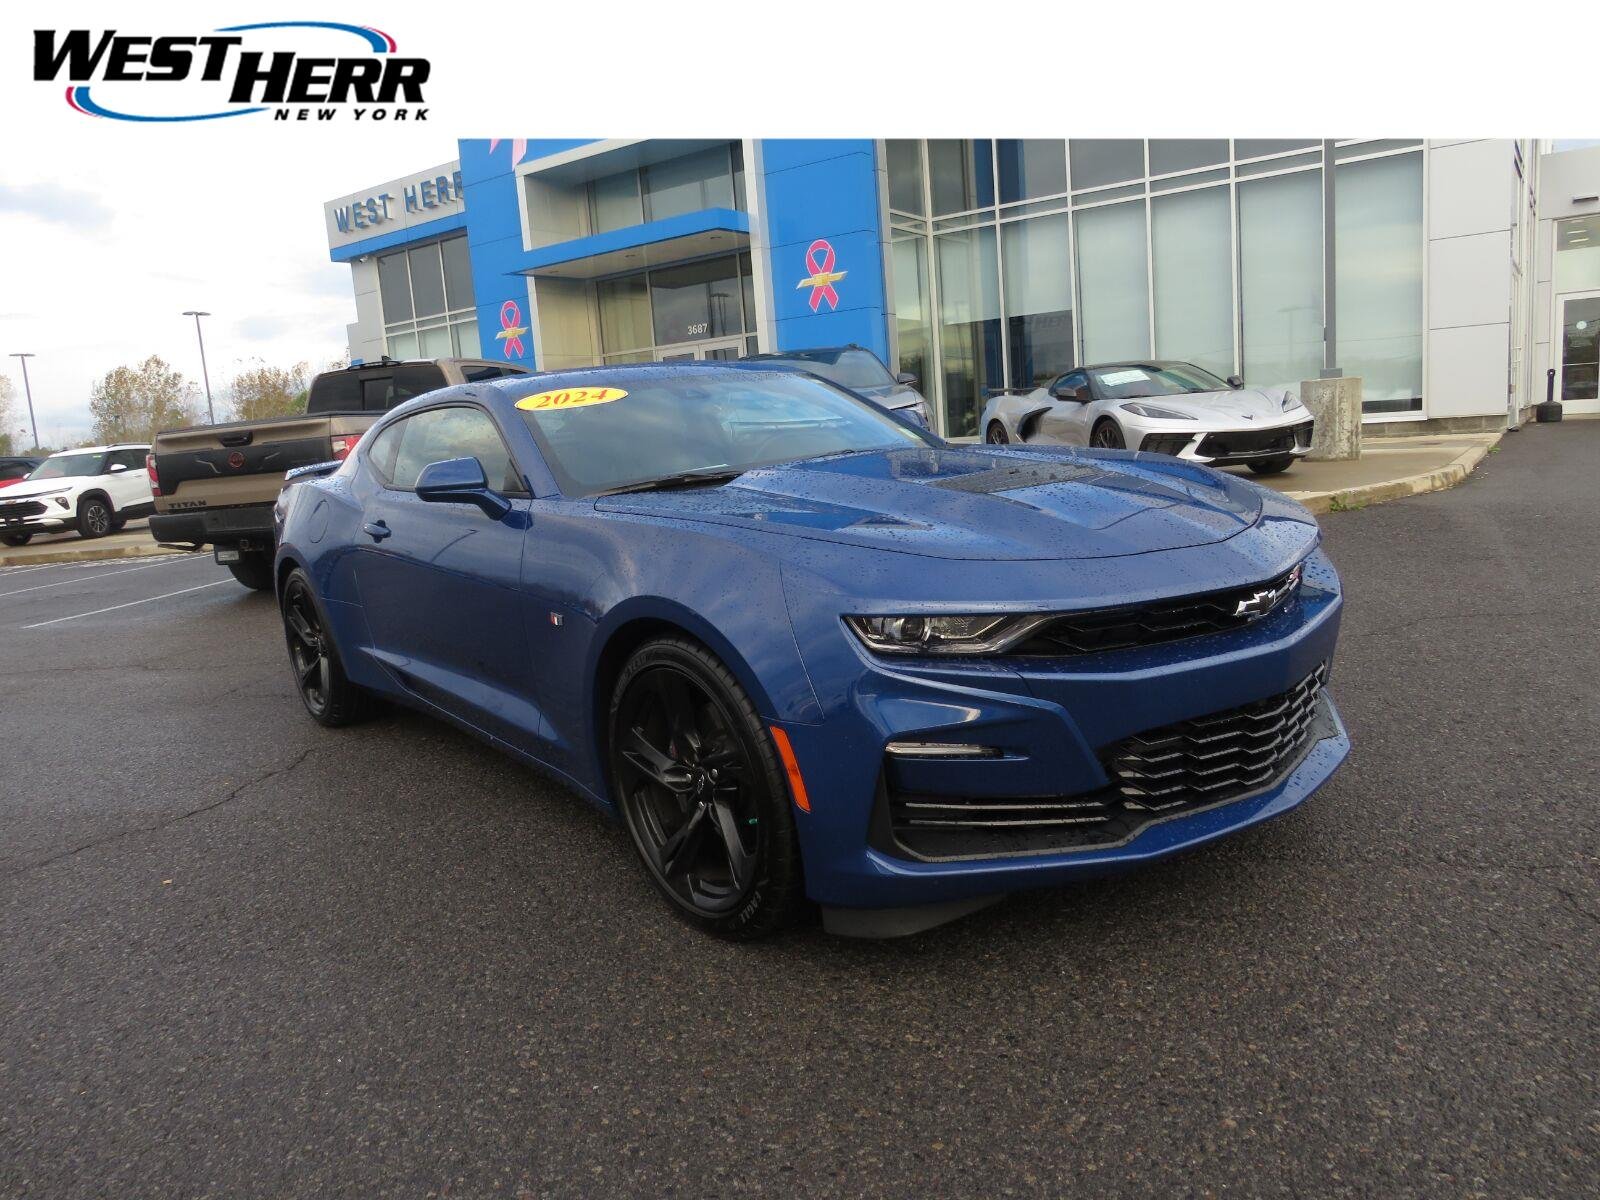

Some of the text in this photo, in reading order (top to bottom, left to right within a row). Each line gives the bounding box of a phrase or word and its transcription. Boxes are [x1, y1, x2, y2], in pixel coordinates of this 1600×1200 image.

[334, 193, 392, 233] WEST
[687, 323, 708, 336] 3687
[534, 388, 608, 409] 2024
[168, 500, 207, 509] TITAN
